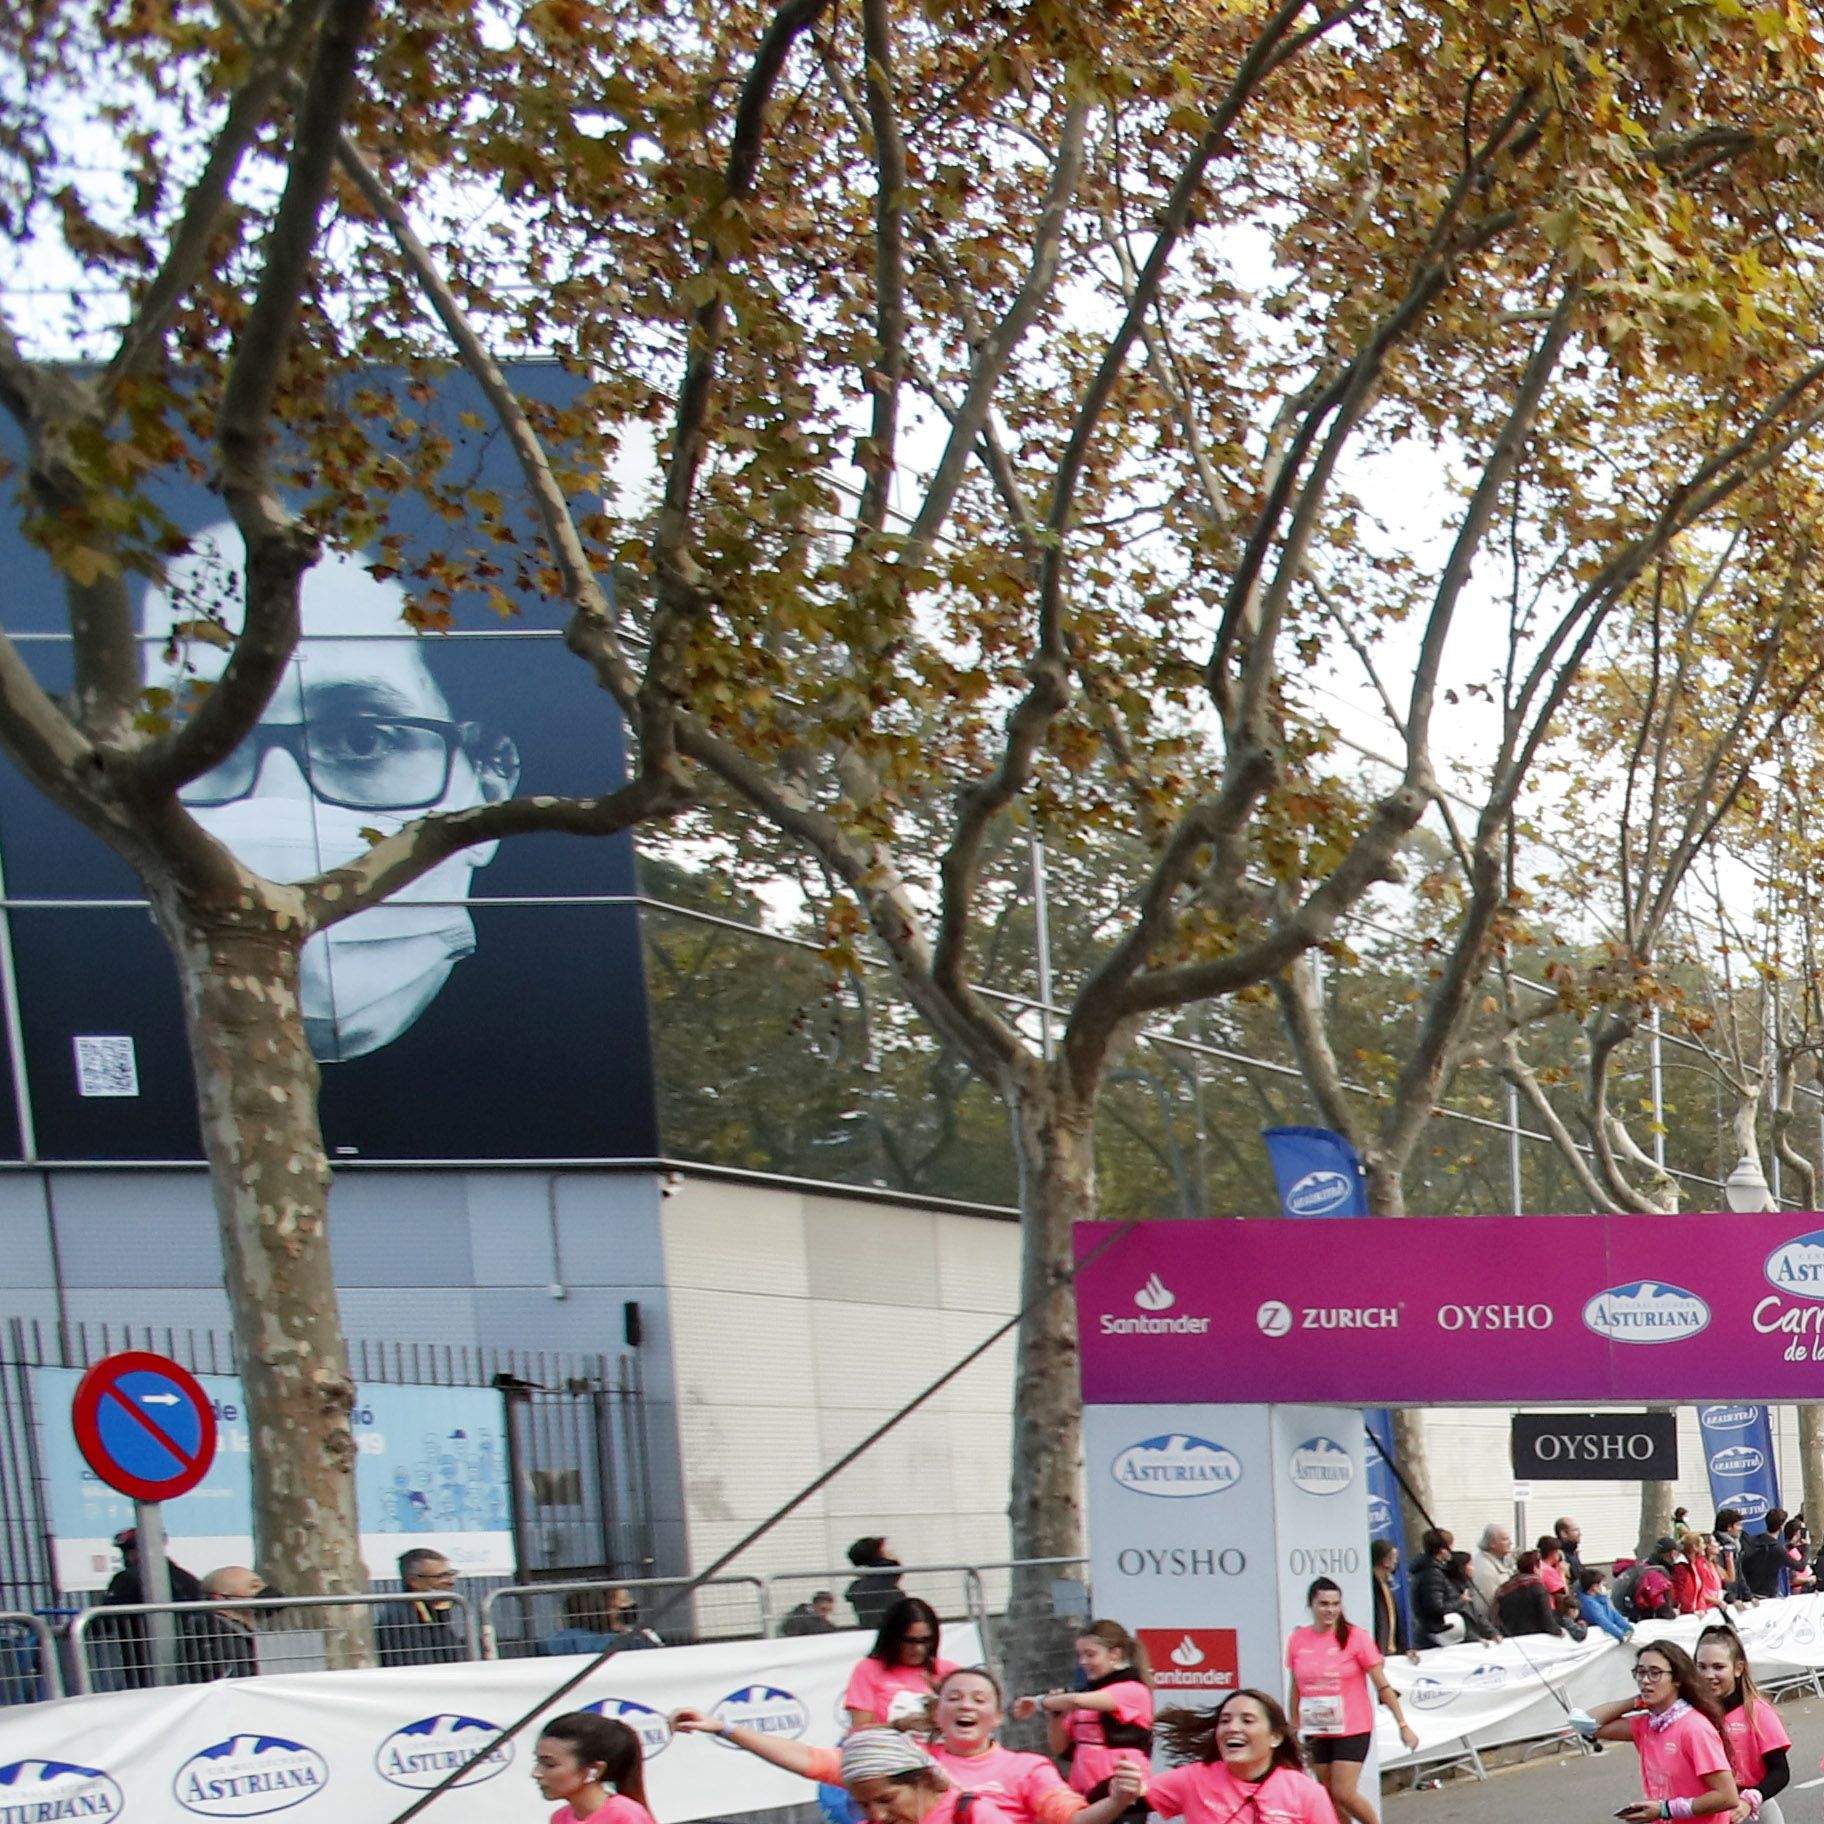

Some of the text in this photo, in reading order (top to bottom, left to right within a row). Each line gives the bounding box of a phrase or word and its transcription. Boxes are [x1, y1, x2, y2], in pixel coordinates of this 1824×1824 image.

[1100, 1314, 1210, 1335] Santander
[1302, 1307, 1399, 1329] ZURICH
[1437, 1304, 1553, 1331] OYSHO
[1593, 1303, 1701, 1327] ASTURIANA
[1784, 1335, 1808, 1361] de
[1534, 1434, 1654, 1460] OYSHO
[1123, 1459, 1233, 1482] ASTURIANA
[1295, 1458, 1350, 1481] ASTURIANA
[1117, 1548, 1247, 1576] OYSHO
[1289, 1547, 1358, 1576] OYSHO
[1149, 1668, 1233, 1685] antander
[389, 1744, 508, 1776] ASTURIA
[187, 1766, 320, 1802] ASTRIANA
